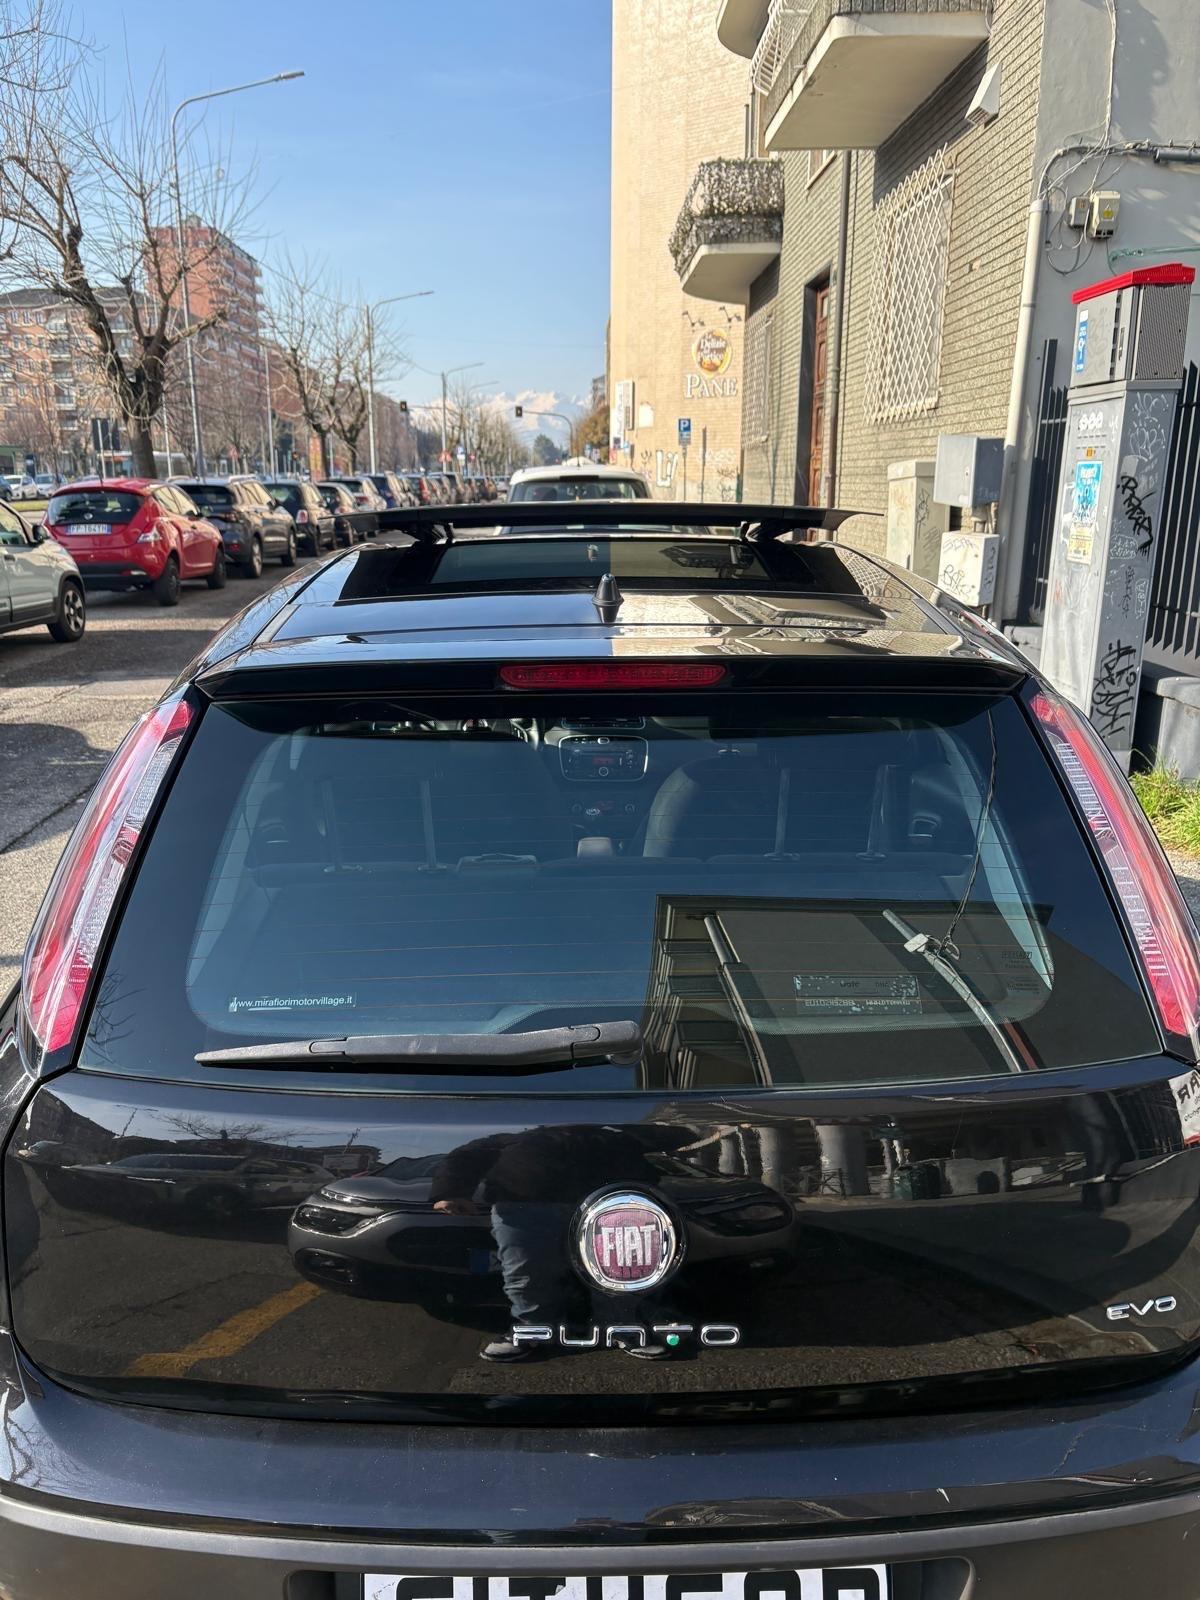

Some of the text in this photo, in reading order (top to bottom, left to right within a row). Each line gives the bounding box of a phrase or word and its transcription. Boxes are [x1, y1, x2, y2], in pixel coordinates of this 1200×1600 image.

[685, 374, 738, 398] PANE
[601, 1224, 656, 1267] FIAT
[1106, 1296, 1177, 1322] EVO
[512, 1323, 741, 1348] PUNTO
